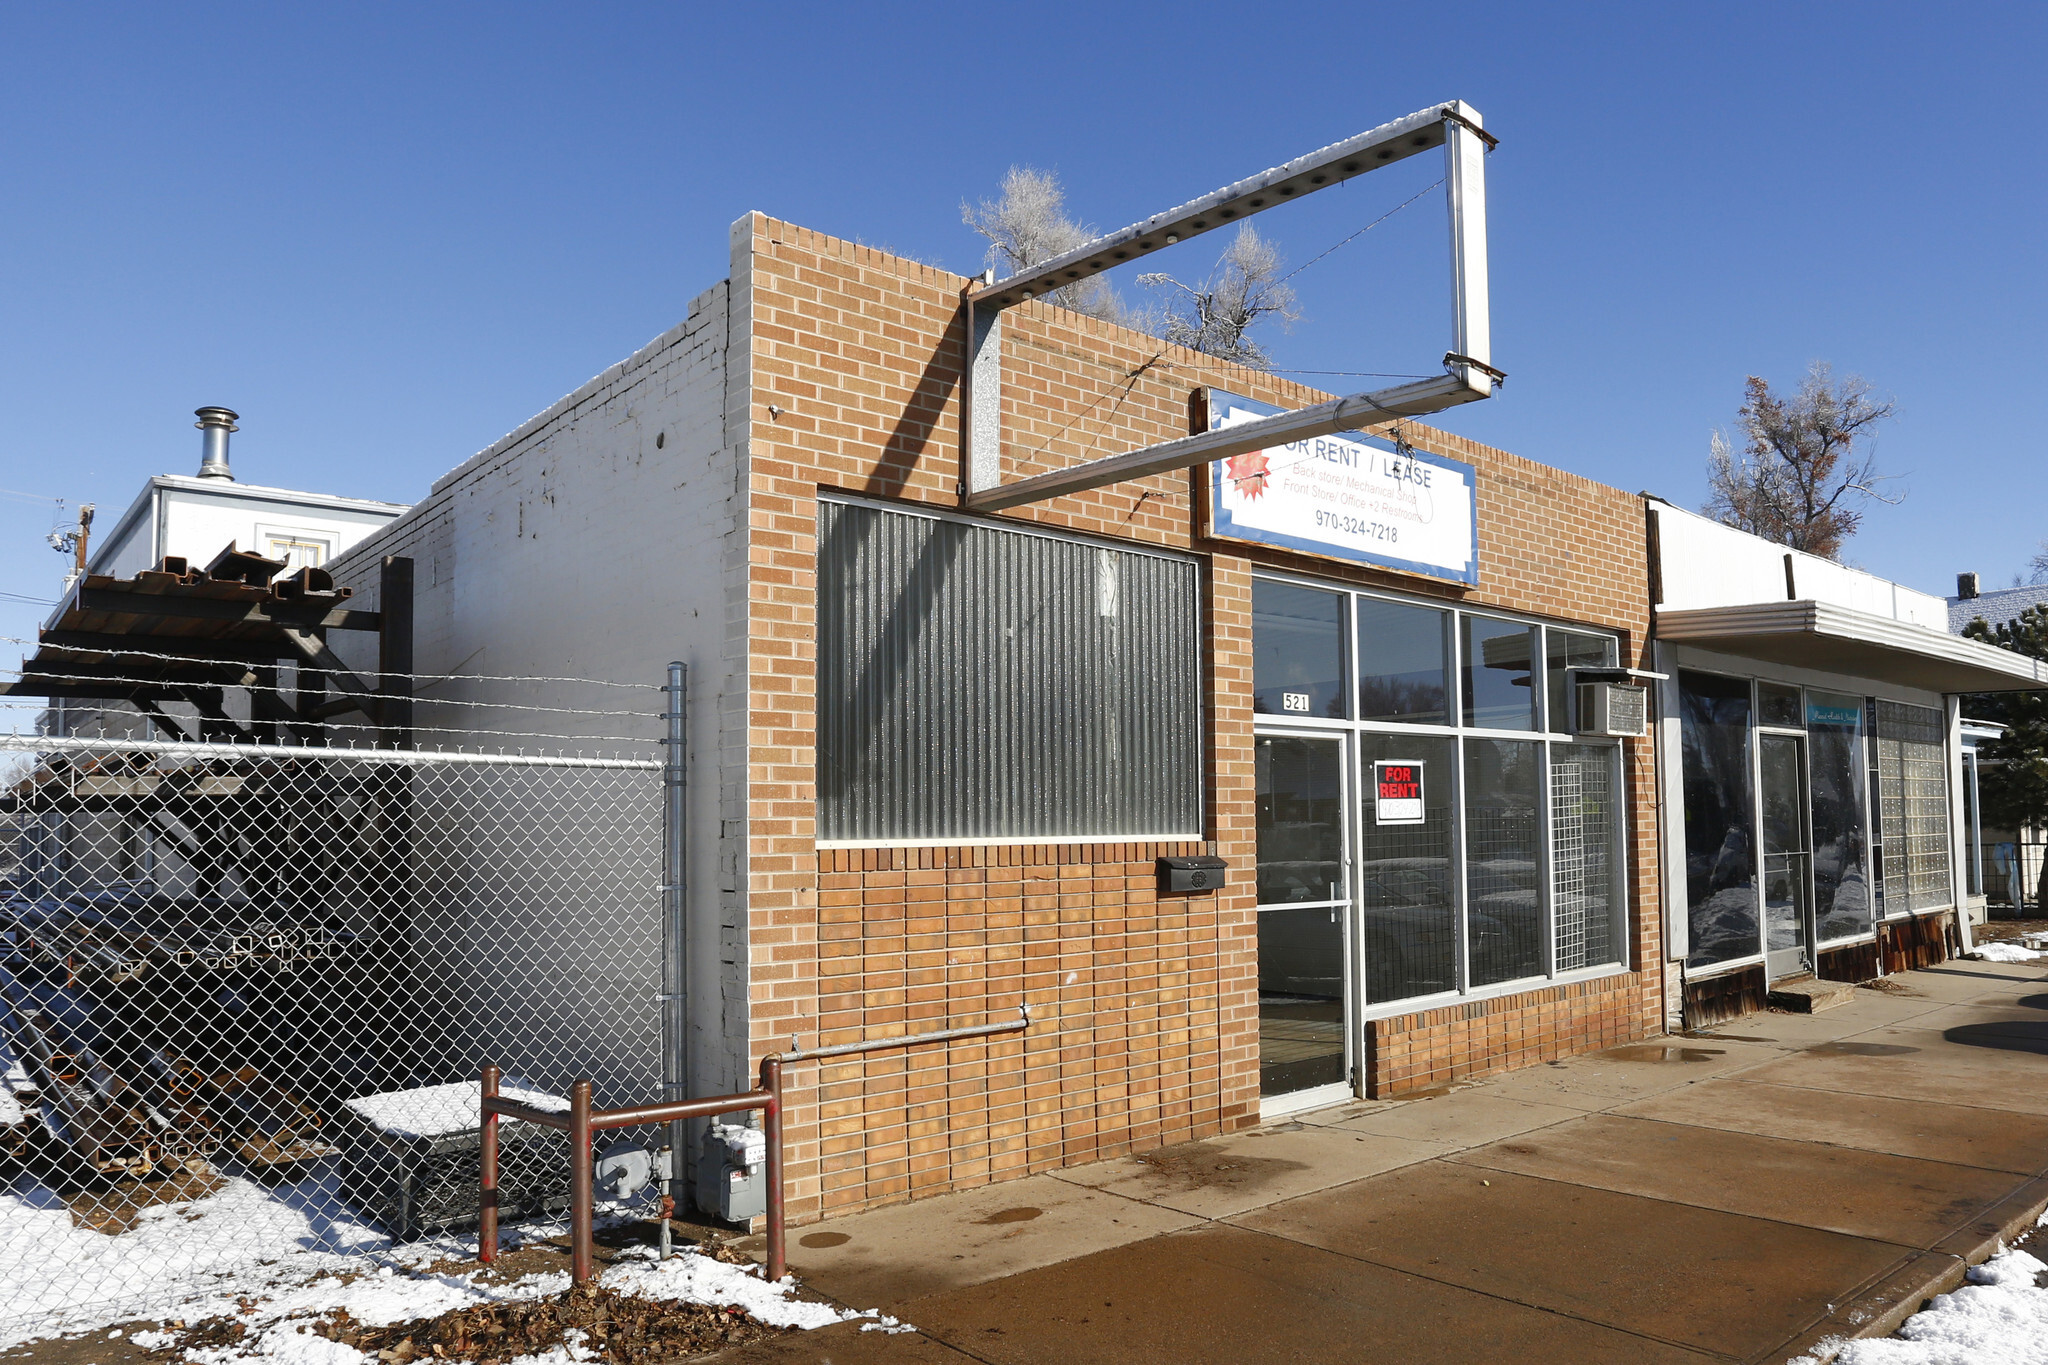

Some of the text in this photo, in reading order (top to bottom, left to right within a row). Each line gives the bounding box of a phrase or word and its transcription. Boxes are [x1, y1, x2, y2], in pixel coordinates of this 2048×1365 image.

[1285, 439, 1432, 488] OR RENT / LEASE
[1284, 478, 1309, 496] Front
[1312, 485, 1339, 502] Store/
[1340, 492, 1366, 510] Office
[1382, 502, 1423, 523] Restrooms
[1293, 462, 1417, 505] Back store/ Mechanical Shop
[1316, 509, 1398, 543] 970-324-7218
[1286, 694, 1306, 710] 521
[1379, 783, 1418, 798] RENT
[1385, 767, 1411, 781] FOR
